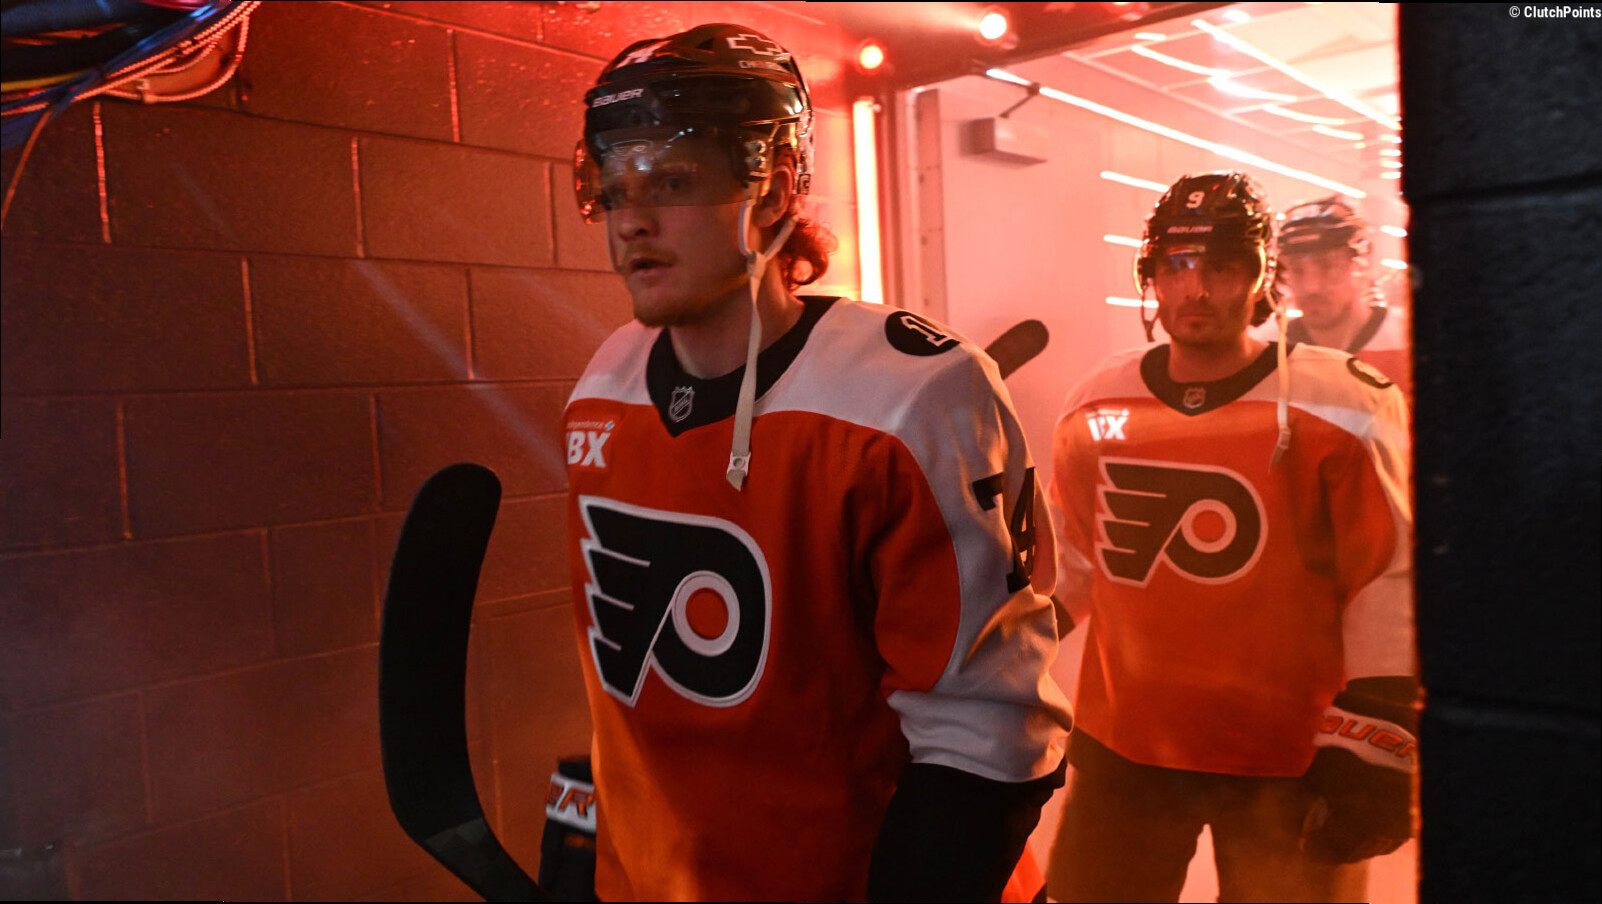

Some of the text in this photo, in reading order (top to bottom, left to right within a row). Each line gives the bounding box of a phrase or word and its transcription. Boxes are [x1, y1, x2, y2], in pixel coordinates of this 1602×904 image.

[591, 88, 645, 108] BAUER
[1186, 191, 1205, 209] 9
[565, 430, 611, 468] BX
